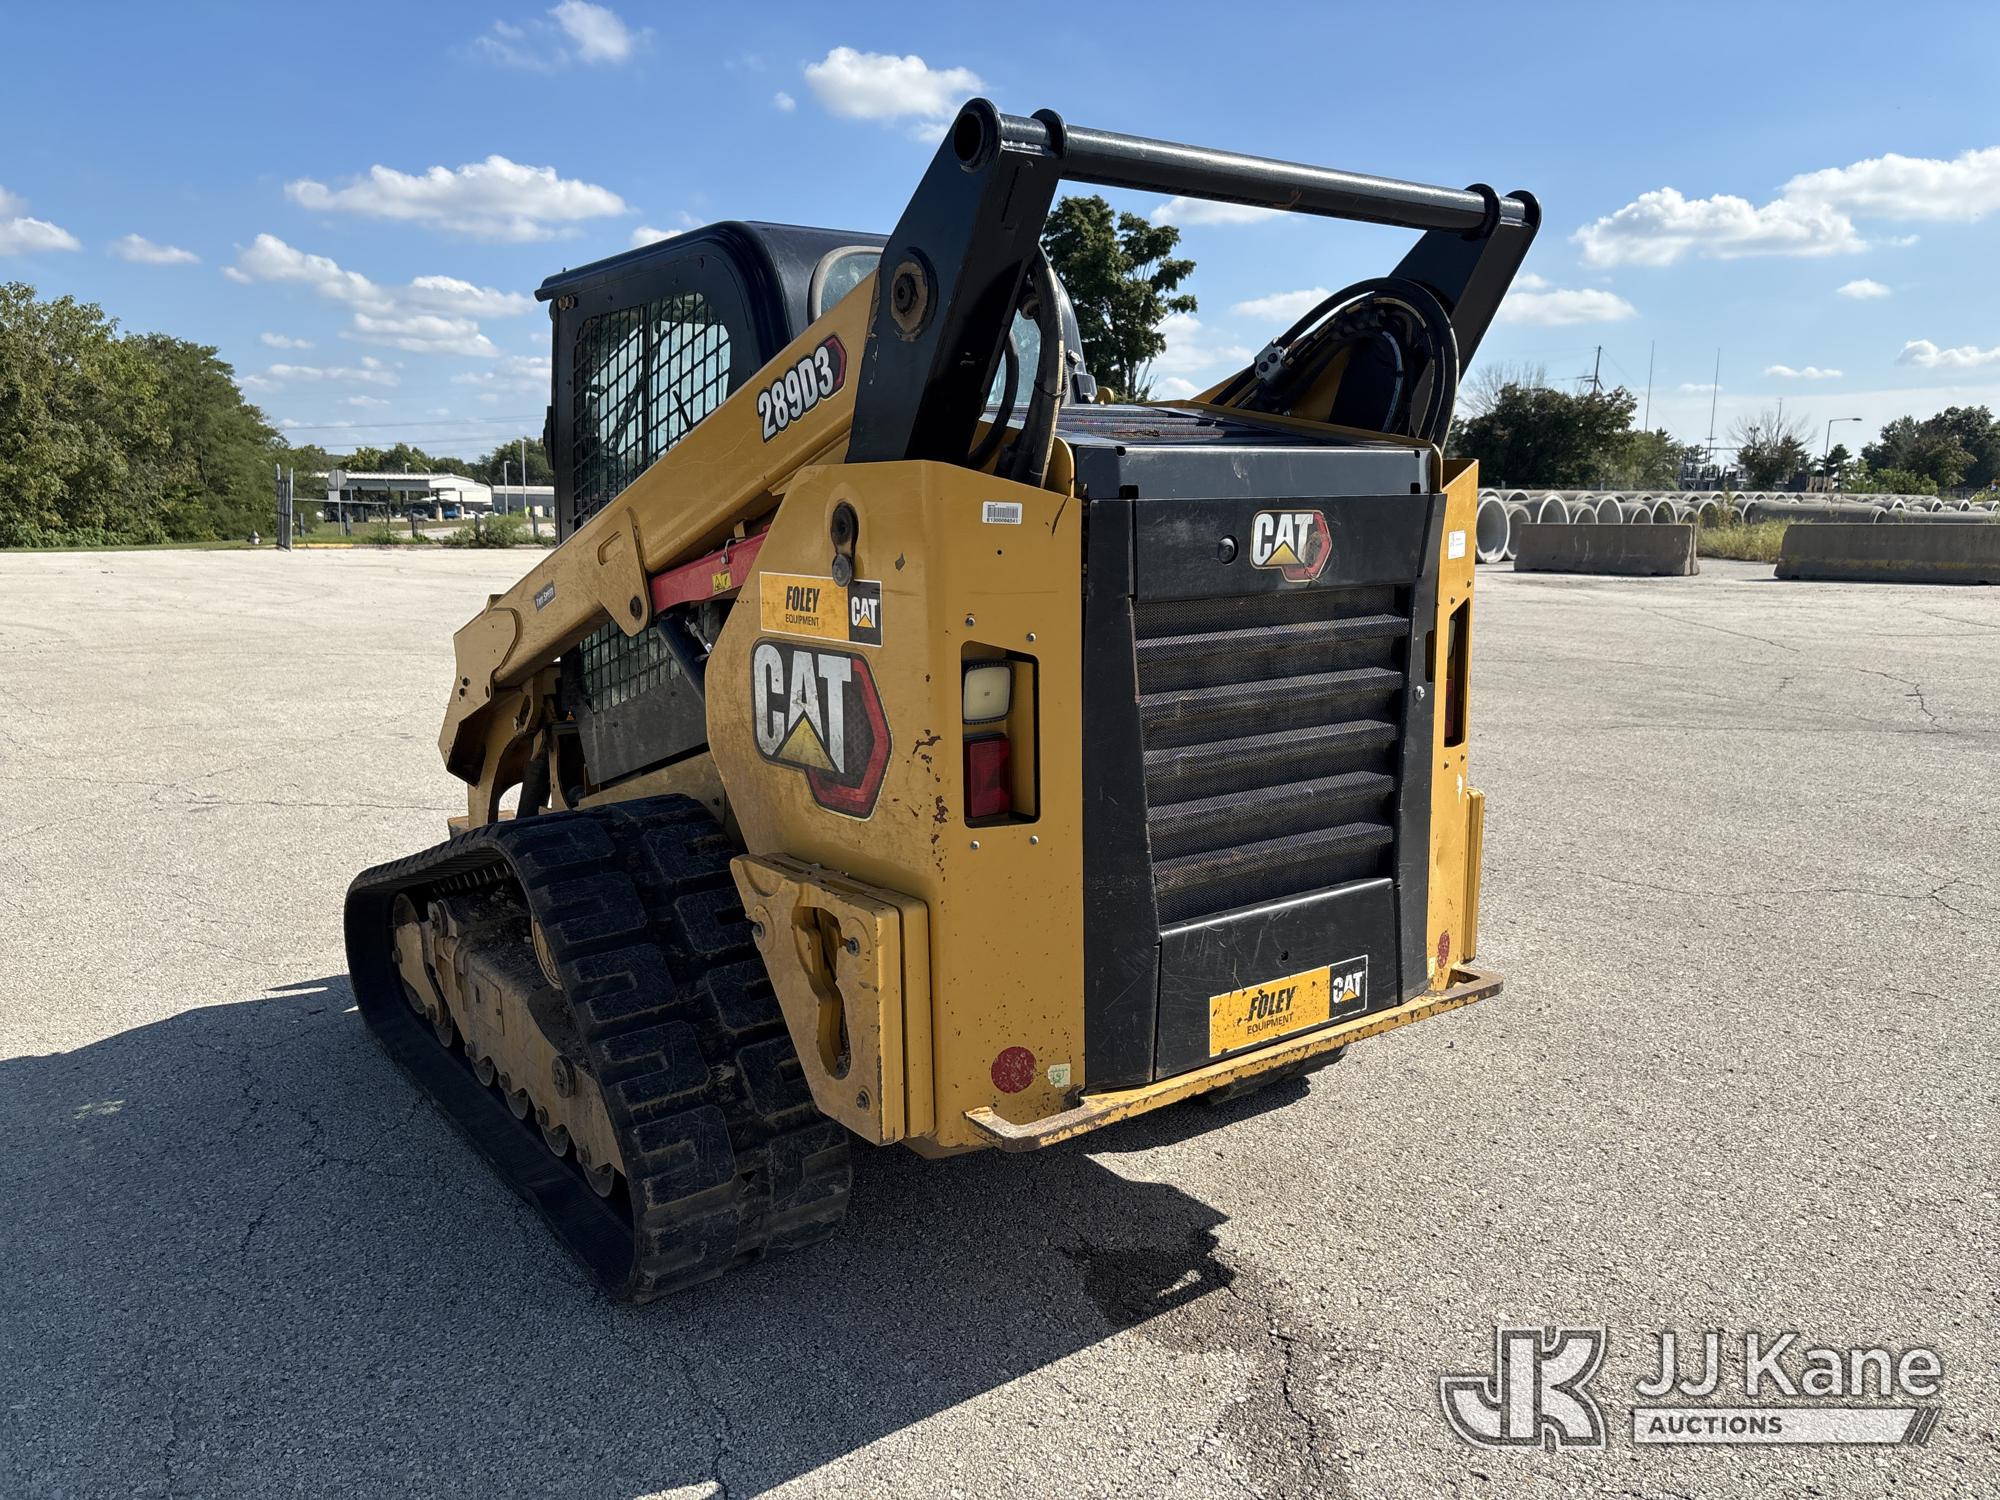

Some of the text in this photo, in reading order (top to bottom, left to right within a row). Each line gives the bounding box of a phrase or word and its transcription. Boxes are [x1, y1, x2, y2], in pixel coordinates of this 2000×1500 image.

[757, 345, 834, 440] 289D3
[1252, 513, 1314, 566] CAT
[785, 586, 820, 613] FOLEY
[851, 596, 879, 629] CAT
[785, 613, 820, 627] EQUIPMENT
[753, 644, 852, 774] CAT
[1249, 986, 1298, 1022] FOLEY
[1333, 971, 1365, 1004] CAT
[1247, 1012, 1295, 1035] EQUIPMENT
